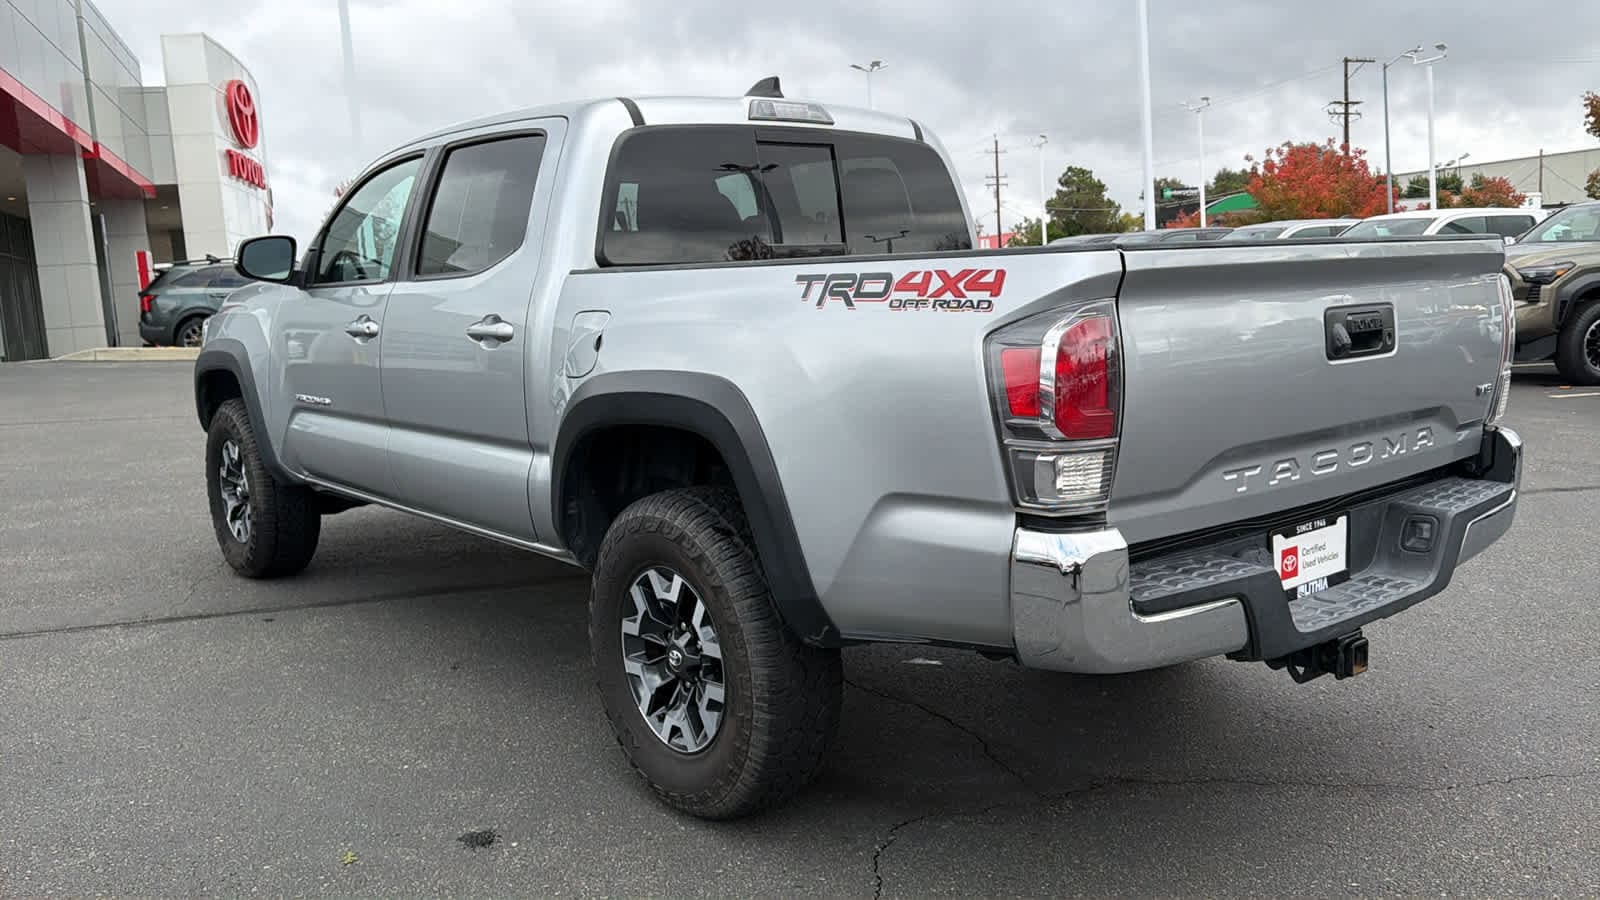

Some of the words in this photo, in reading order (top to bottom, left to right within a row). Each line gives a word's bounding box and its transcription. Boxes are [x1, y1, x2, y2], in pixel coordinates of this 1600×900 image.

[795, 271, 896, 310] TRD
[893, 268, 1007, 299] 4X4
[888, 298, 930, 312] OFF
[931, 298, 994, 312] ROAD
[1222, 426, 1434, 493] TACOMA
[1297, 521, 1313, 533] SINCE
[1302, 543, 1327, 556] Certified
[1303, 558, 1316, 568] Used
[1317, 552, 1339, 563] Vehicles
